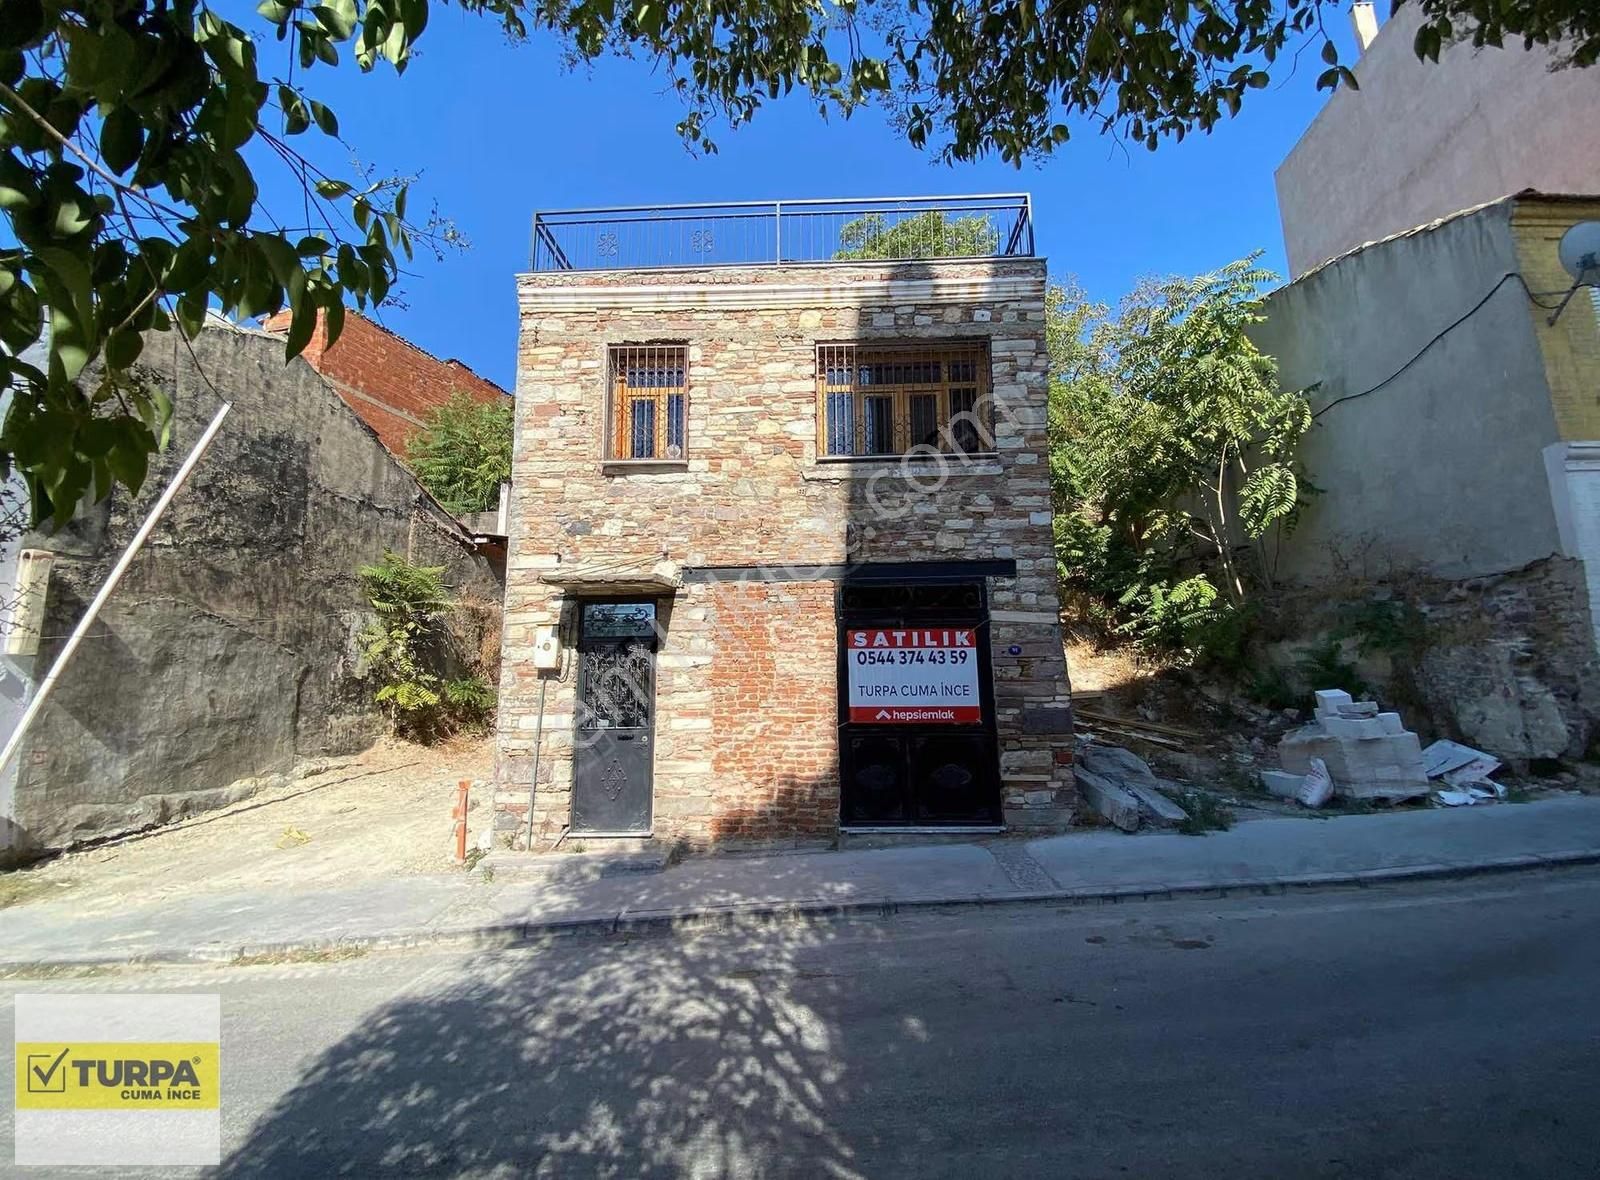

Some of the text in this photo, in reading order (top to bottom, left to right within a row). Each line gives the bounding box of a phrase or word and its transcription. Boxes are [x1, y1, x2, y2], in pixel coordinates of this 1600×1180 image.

[853, 631, 971, 647] SATILIK
[857, 650, 968, 665] 0544 374 43 59
[858, 682, 970, 697] TURPA CUMA İNCE
[893, 709, 955, 721] hepsiemlak
